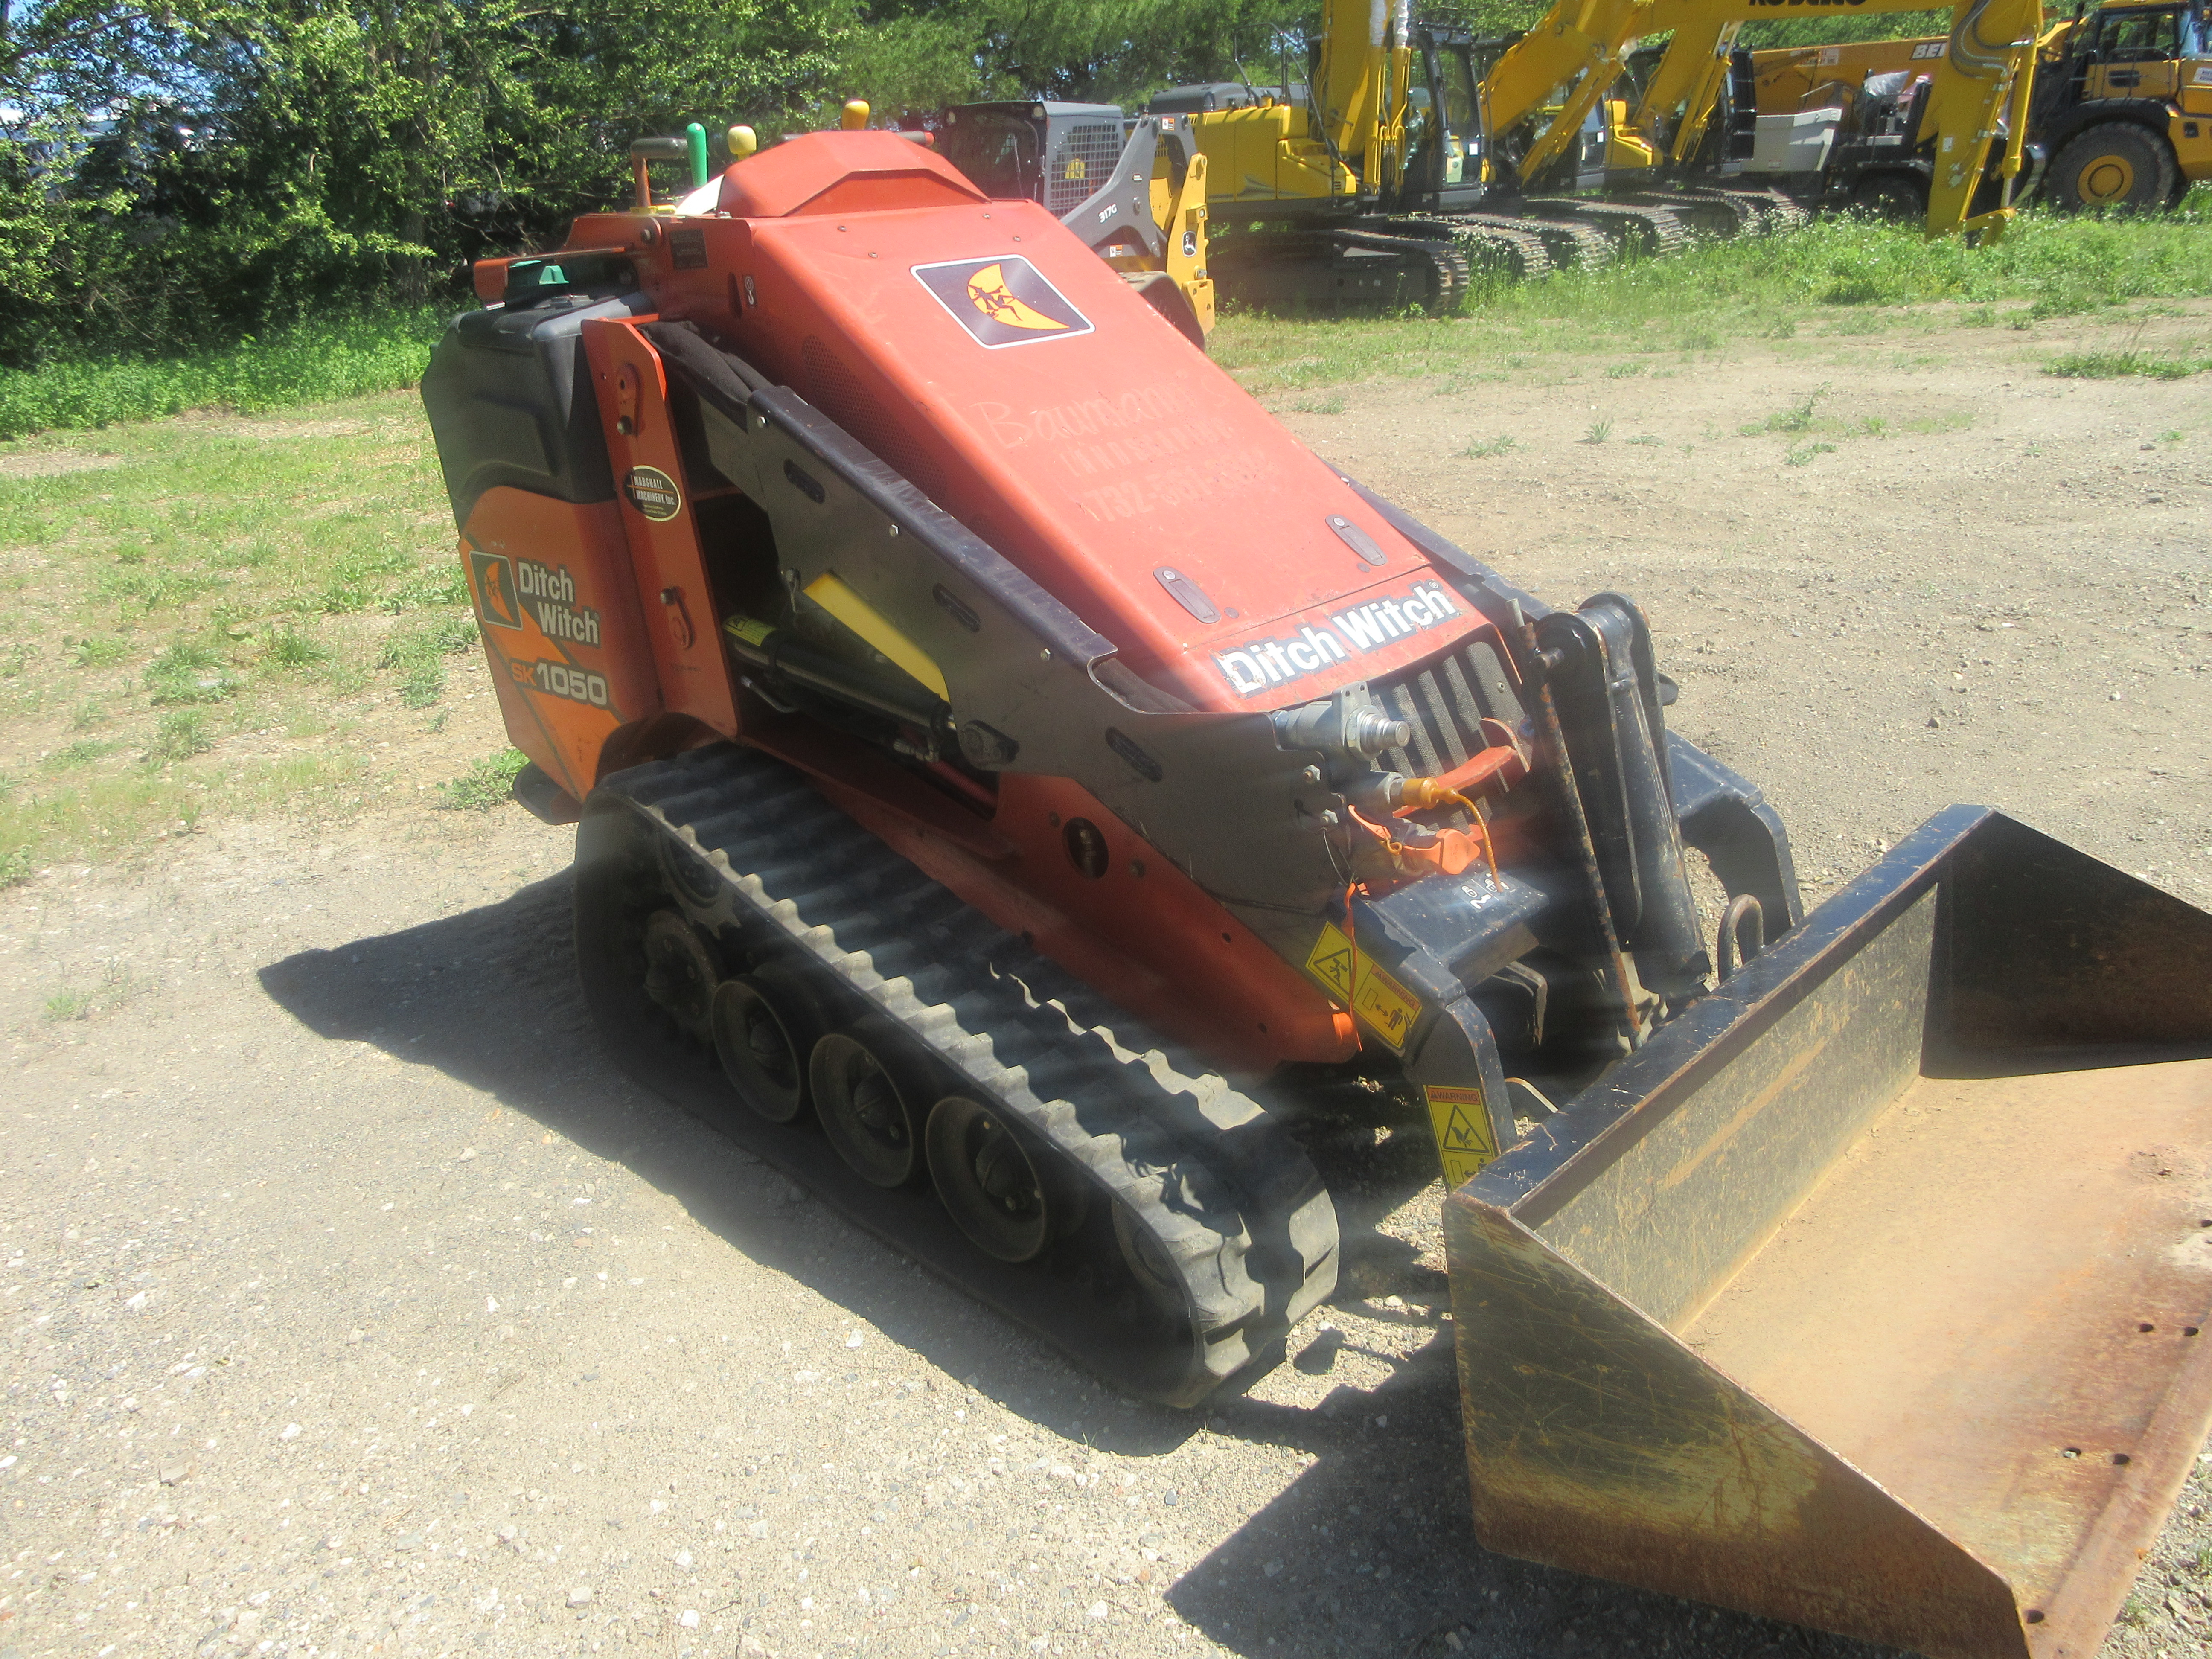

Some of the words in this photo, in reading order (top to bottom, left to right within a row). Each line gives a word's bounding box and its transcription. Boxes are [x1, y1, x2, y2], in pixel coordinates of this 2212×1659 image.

[1098, 204, 1118, 223] 317G
[634, 475, 663, 490] MARSHALL
[518, 561, 574, 602] Ditch
[537, 601, 598, 644] Witch
[1217, 627, 1347, 694] Ditch
[1332, 585, 1458, 650] Witch
[512, 663, 536, 686] SK
[536, 662, 607, 705] 1050
[1381, 975, 1415, 1007] WARNING
[1437, 1091, 1478, 1102] WARNING
